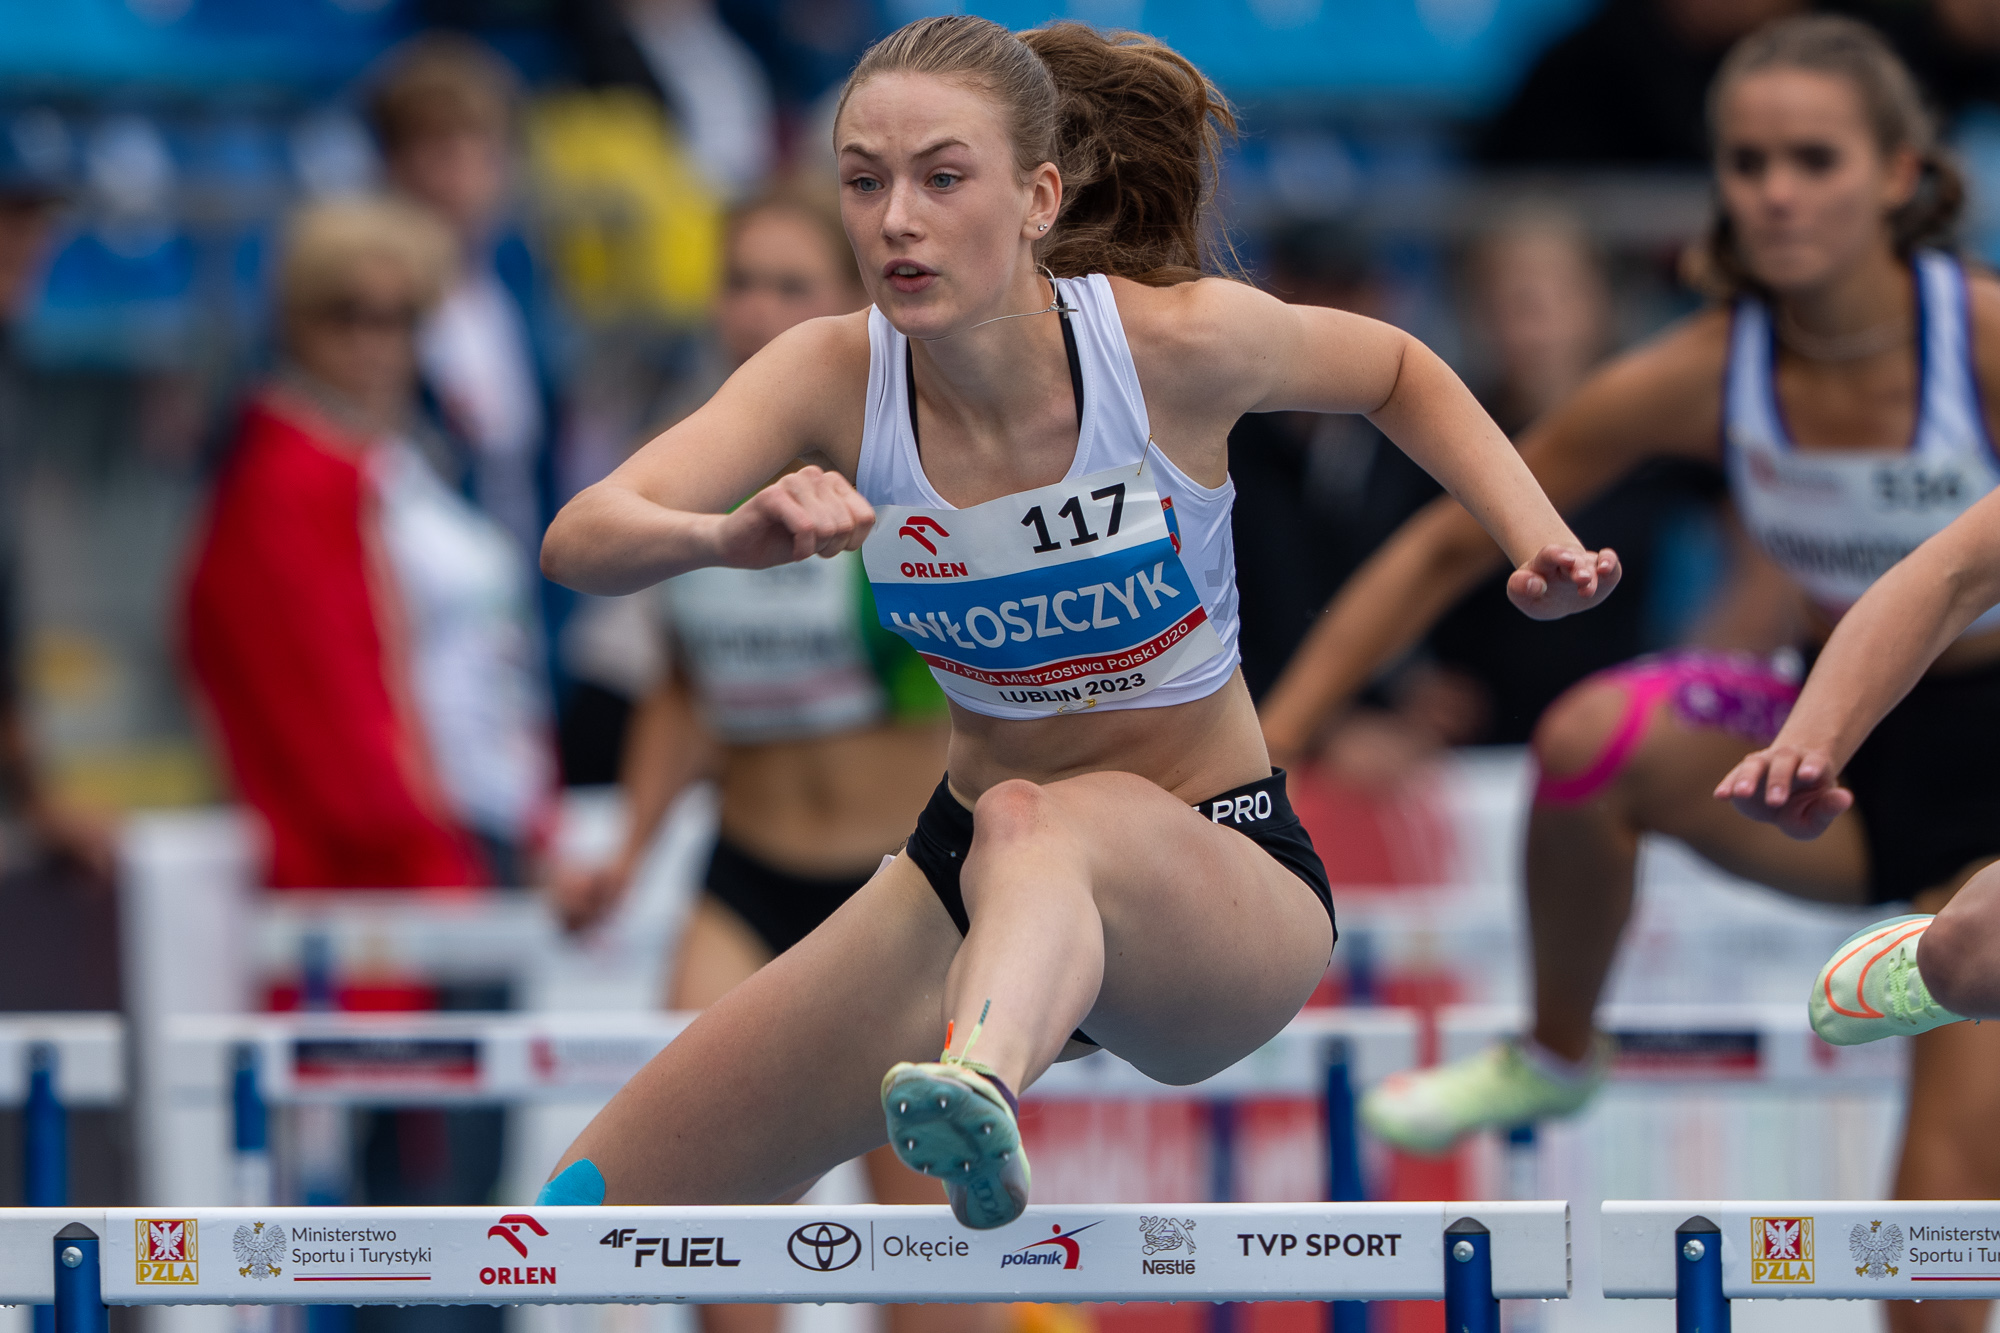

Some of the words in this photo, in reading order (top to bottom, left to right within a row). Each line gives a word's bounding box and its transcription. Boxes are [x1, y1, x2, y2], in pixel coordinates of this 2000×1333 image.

[1021, 482, 1126, 554] 117
[900, 562, 969, 578] ORLEN
[890, 561, 1181, 650] WŁOSZCZYK
[940, 660, 963, 675] 77.
[963, 667, 1000, 684] PZLA
[1001, 661, 1103, 685] Mistrzostwa
[1107, 645, 1157, 670] Polski
[1159, 622, 1189, 649] U20
[998, 686, 1082, 703] LUBLIN
[1084, 672, 1146, 696] 2023
[1211, 790, 1272, 824] PRO
[291, 1227, 397, 1242] Ministerstwo
[1236, 1233, 1297, 1257] TVP
[1305, 1233, 1402, 1257] SPORT
[291, 1248, 345, 1266] Sportu
[359, 1247, 432, 1265] Turystyki
[599, 1228, 638, 1248] 4F
[634, 1237, 741, 1268] FUEL
[883, 1235, 969, 1262] Okęcie
[1909, 1247, 1963, 1266] Sportu
[1000, 1250, 1064, 1269] polanik
[139, 1263, 195, 1281] PZLA
[479, 1266, 557, 1285] ORLEN
[1754, 1262, 1812, 1281] PZLA
